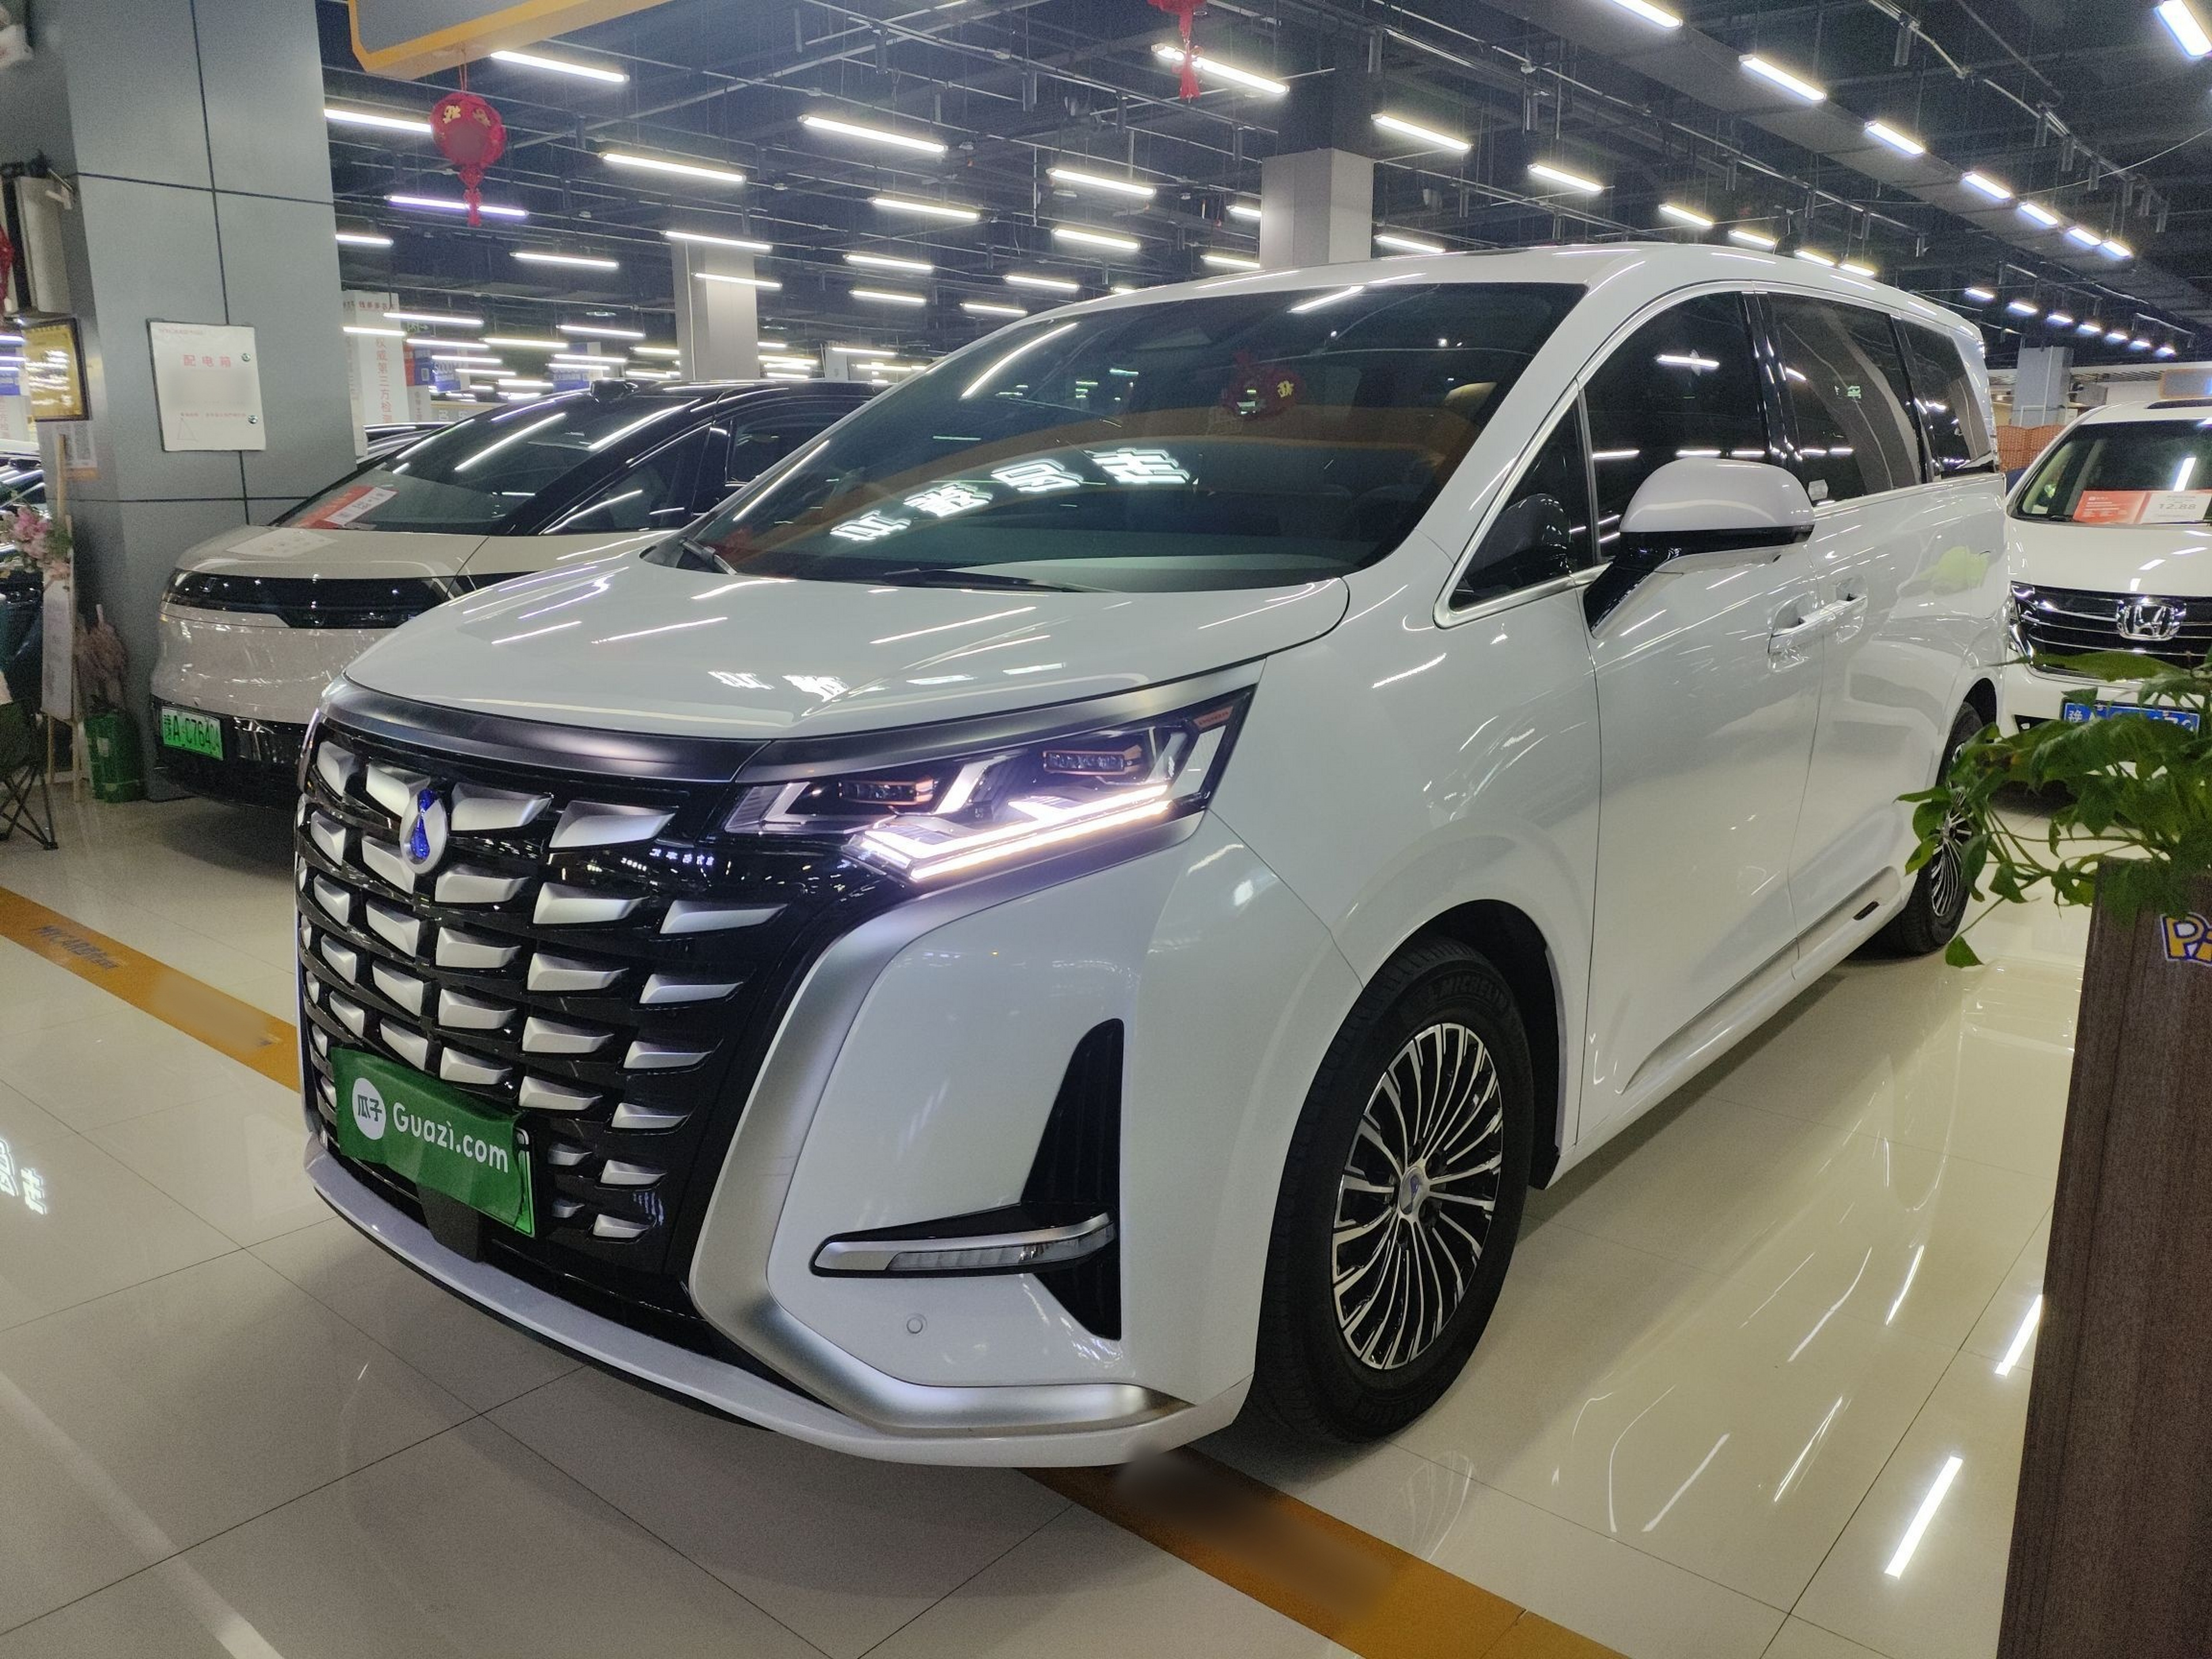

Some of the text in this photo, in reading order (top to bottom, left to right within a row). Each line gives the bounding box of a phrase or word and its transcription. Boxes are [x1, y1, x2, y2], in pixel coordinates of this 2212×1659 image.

[183, 354, 232, 368] 配电箱
[357, 1093, 382, 1122] 瓜子
[393, 1101, 508, 1173] Guazi.com
